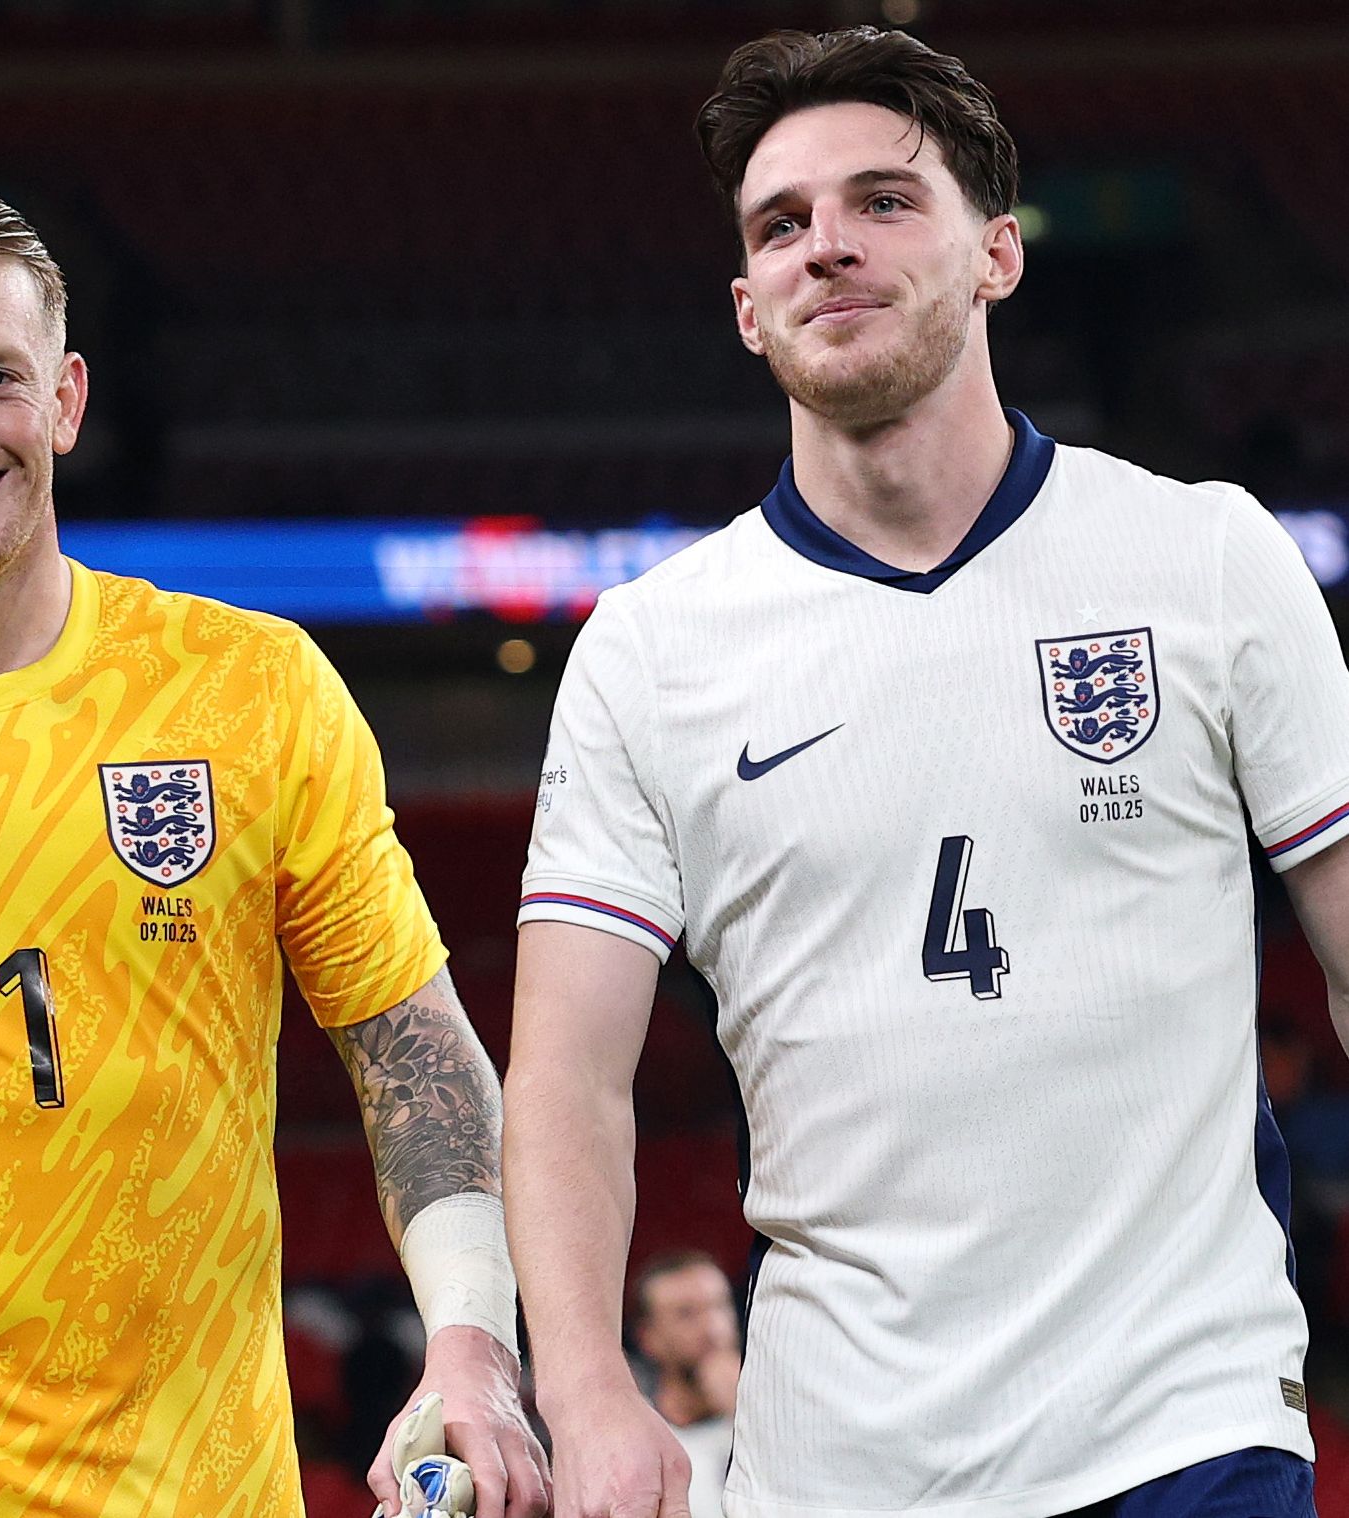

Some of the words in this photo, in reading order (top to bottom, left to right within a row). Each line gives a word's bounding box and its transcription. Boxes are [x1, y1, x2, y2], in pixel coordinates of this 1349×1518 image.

[1080, 775, 1140, 796] WALES
[1080, 800, 1143, 823] 09.10.25
[141, 896, 193, 917] WALES
[922, 835, 1010, 1000] 4
[140, 922, 197, 943] 09.10.25
